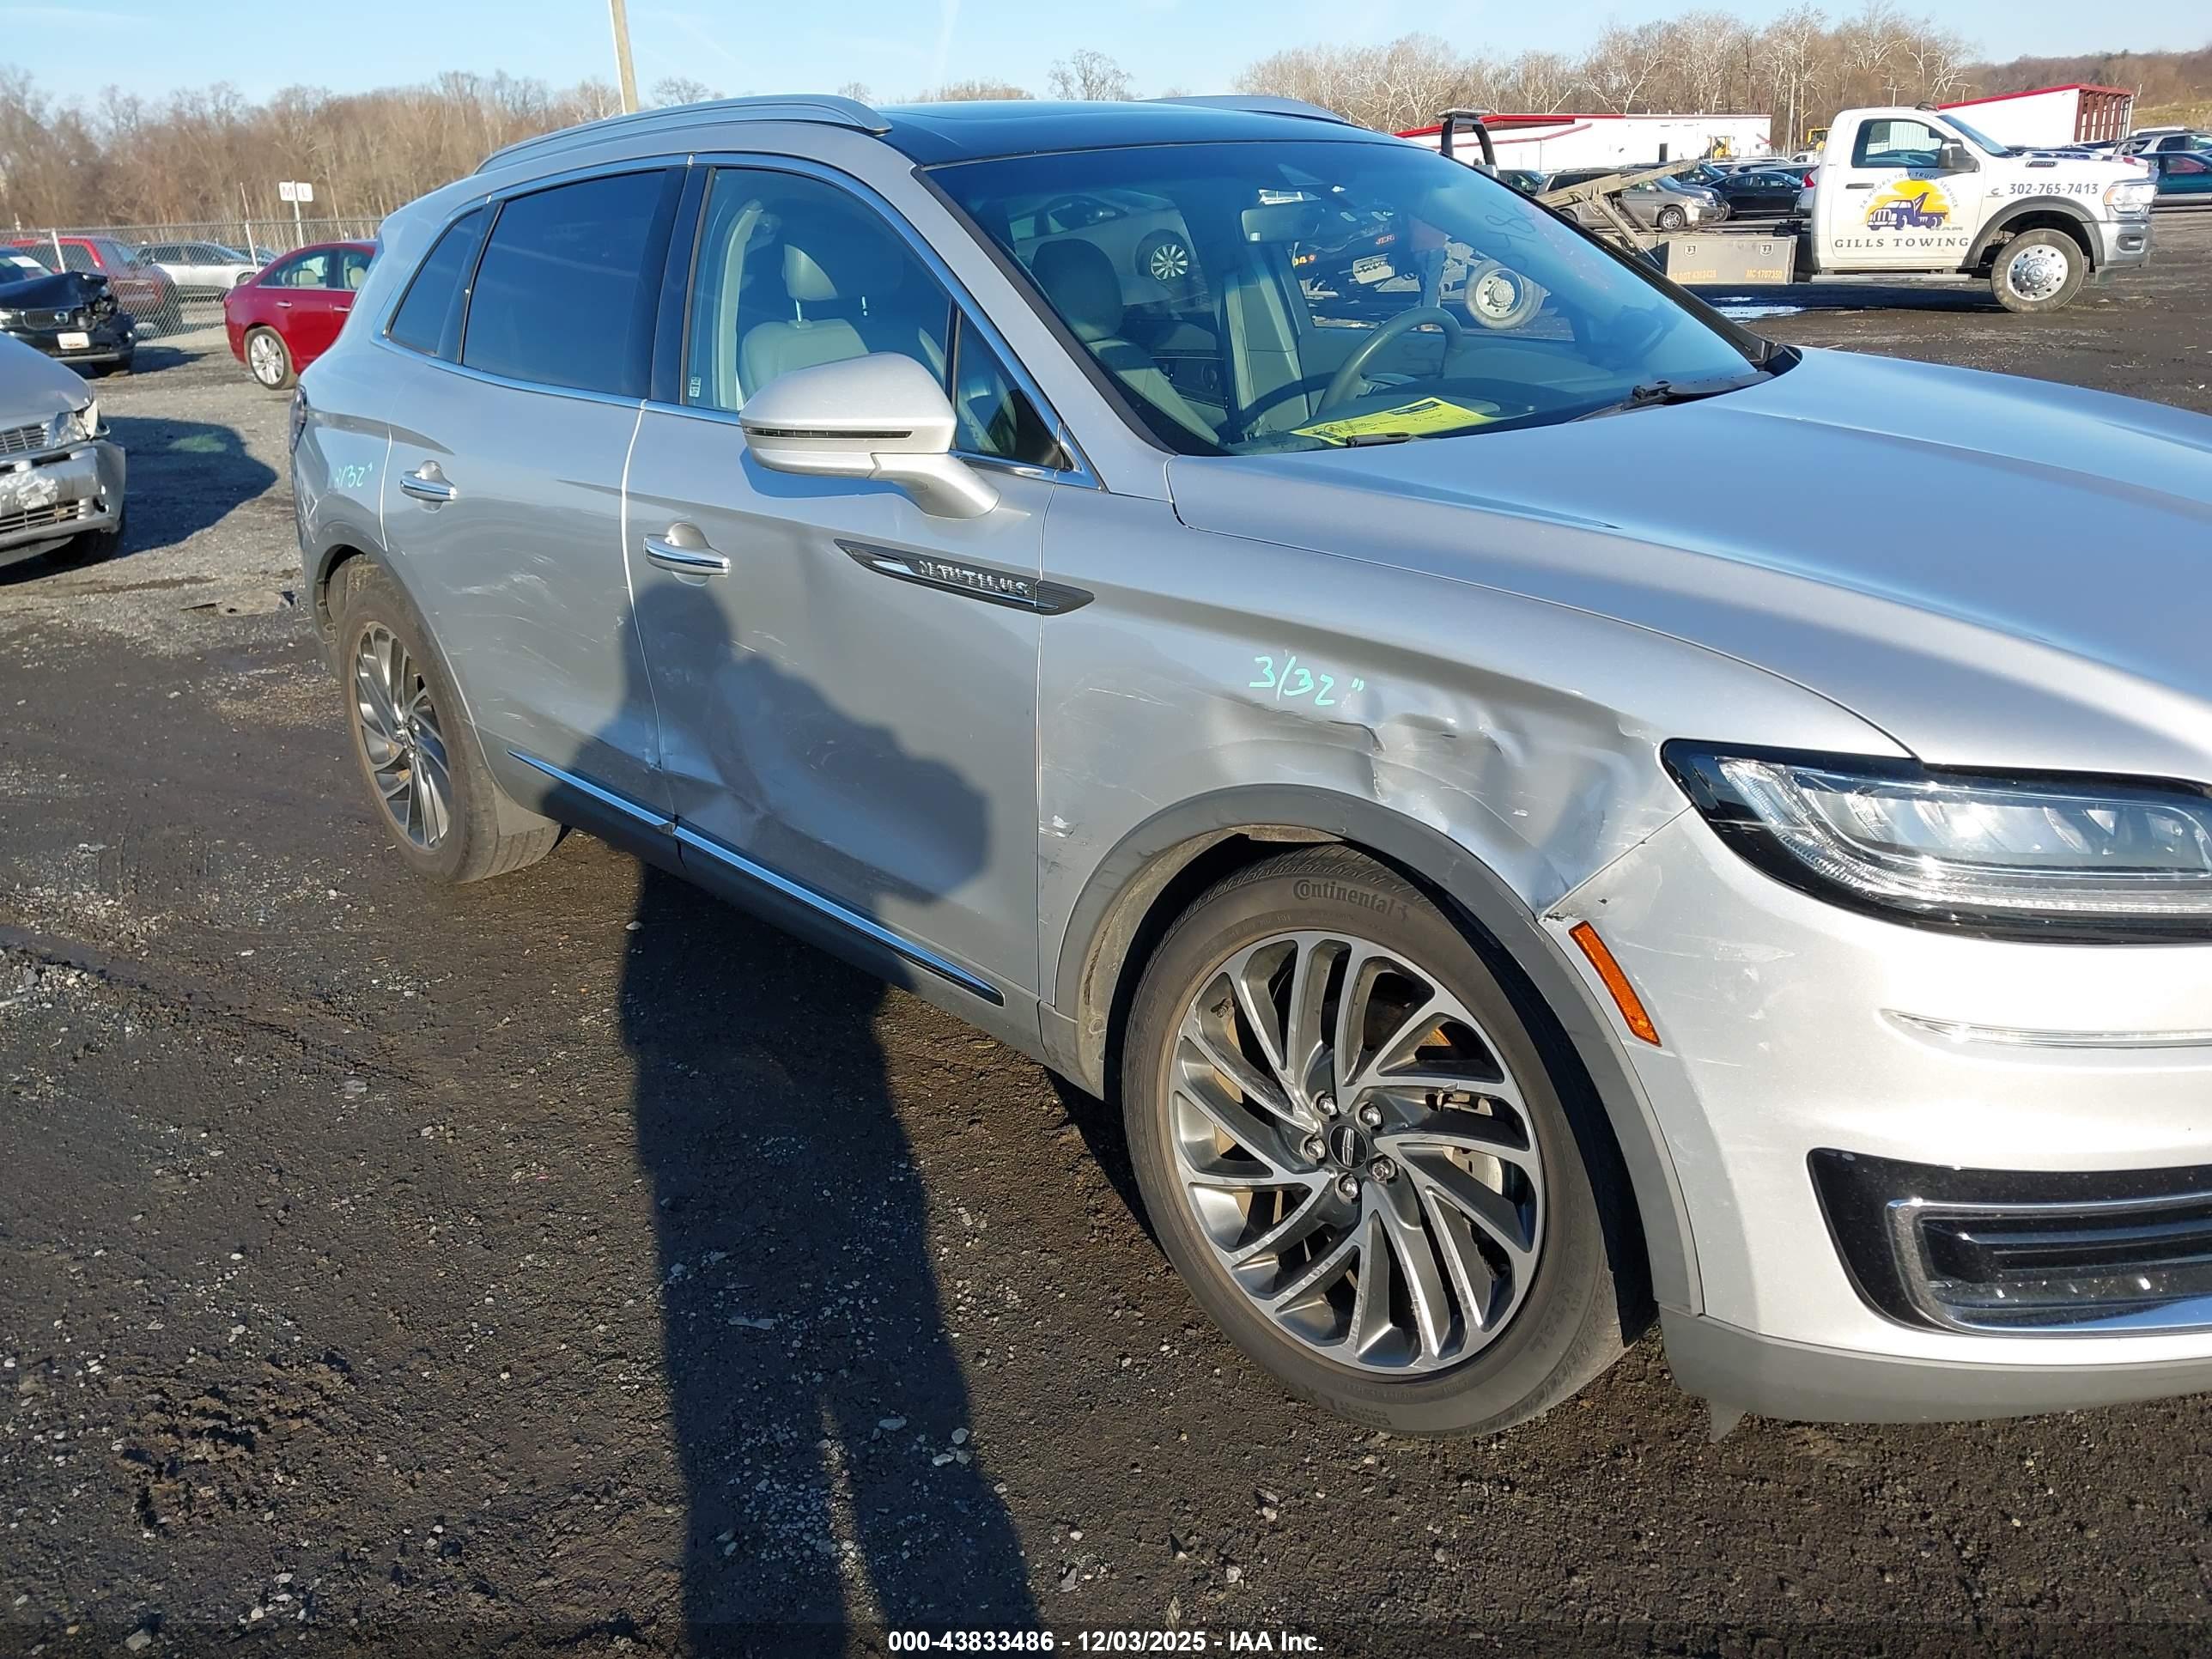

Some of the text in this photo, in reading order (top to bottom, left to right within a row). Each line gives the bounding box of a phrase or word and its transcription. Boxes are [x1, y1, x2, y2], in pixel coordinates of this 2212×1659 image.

[2008, 183, 2100, 195] 302-765-7413
[1834, 237, 1970, 249] GILLS TOWING
[918, 560, 1030, 596] NAUTILUS
[1292, 878, 1395, 916] Continental
